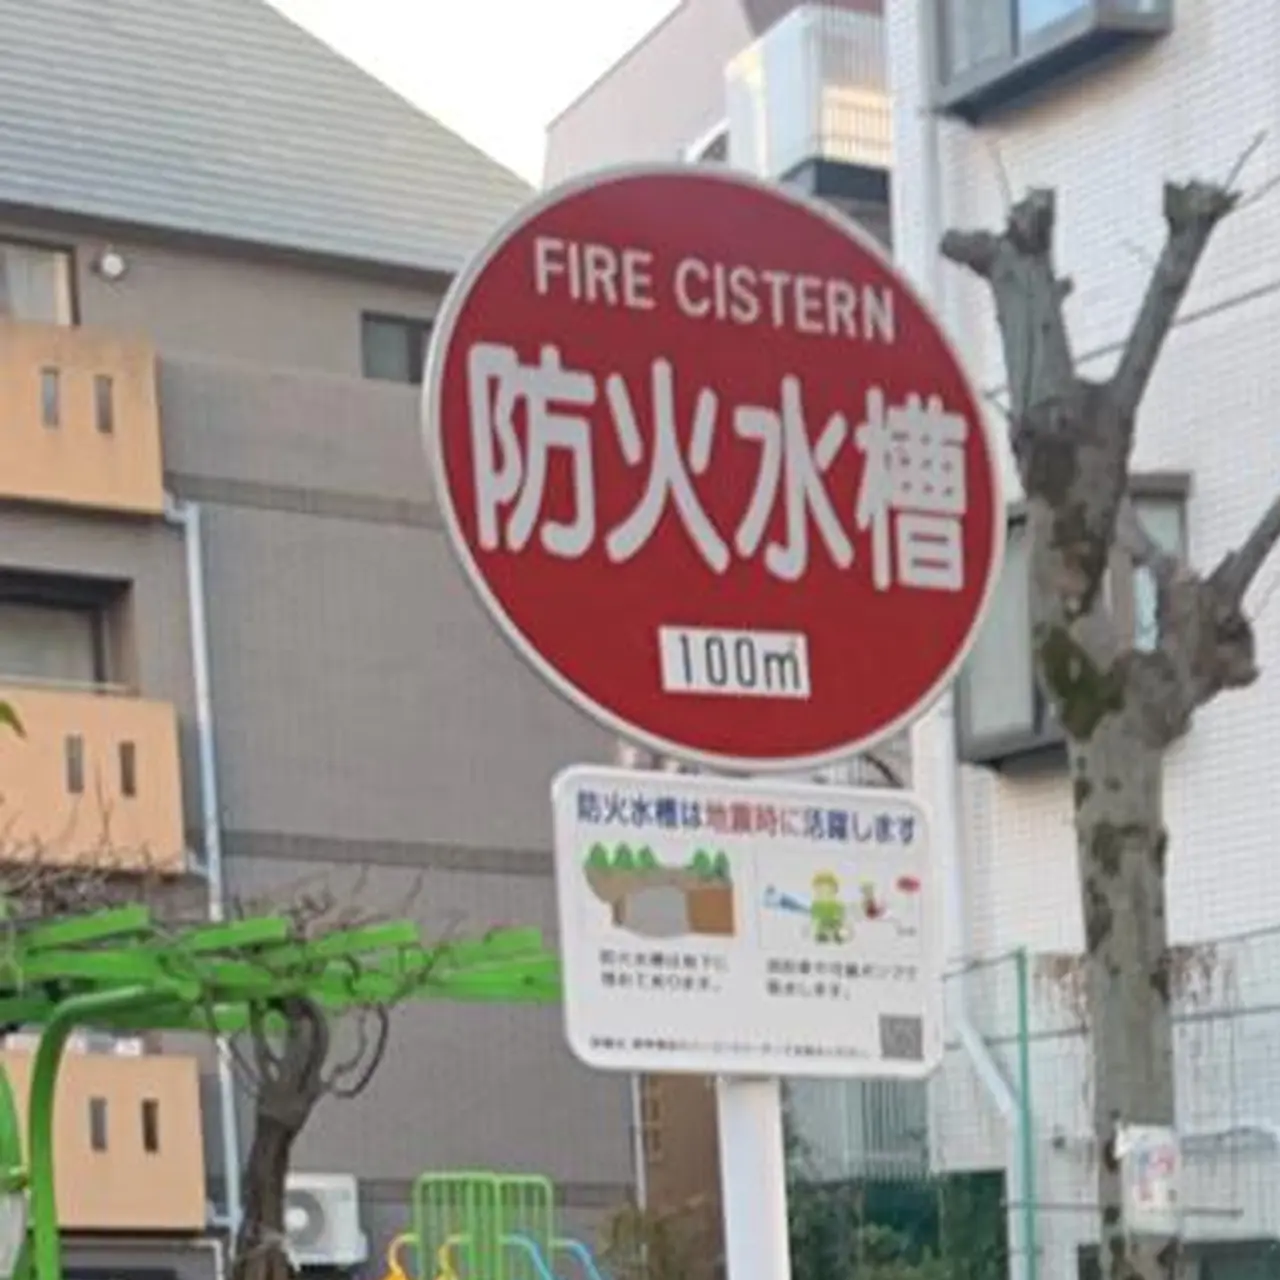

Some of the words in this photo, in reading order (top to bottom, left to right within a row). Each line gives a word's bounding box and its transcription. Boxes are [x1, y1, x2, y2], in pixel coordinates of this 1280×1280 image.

[534, 236, 655, 309] FIRE
[675, 258, 896, 343] CISTERN
[468, 341, 968, 592] 防火水槽
